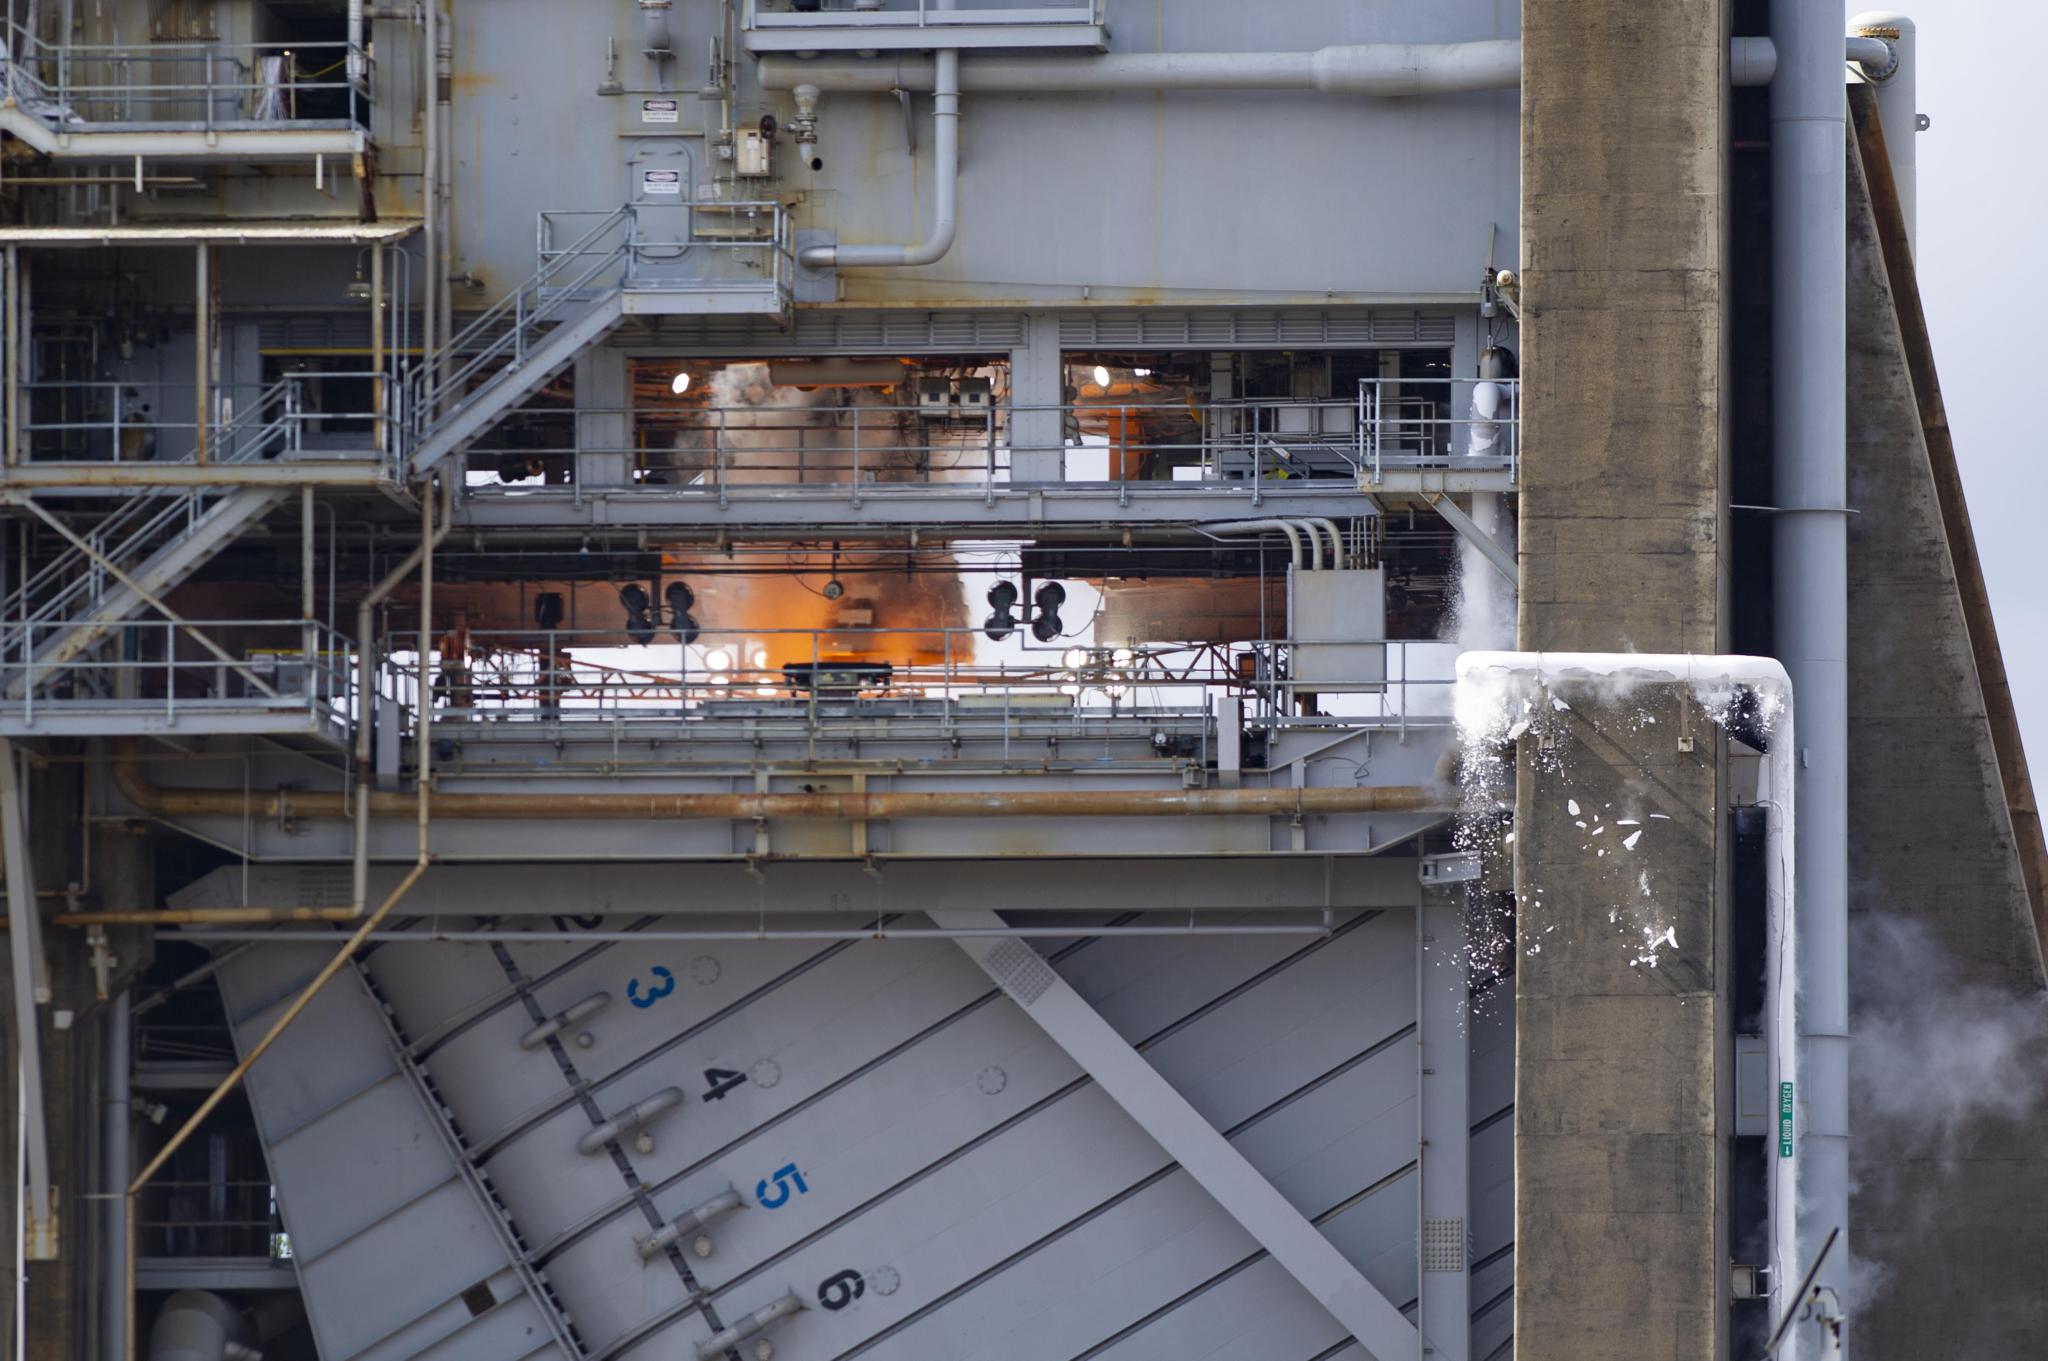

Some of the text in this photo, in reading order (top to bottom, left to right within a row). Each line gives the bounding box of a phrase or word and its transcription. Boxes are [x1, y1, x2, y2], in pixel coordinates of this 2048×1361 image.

[627, 966, 675, 1009] 3
[702, 1068, 748, 1102] 4
[1782, 1083, 1792, 1145] LIQUID OXYGEN
[756, 1162, 809, 1209] 5
[818, 1269, 865, 1311] 6
